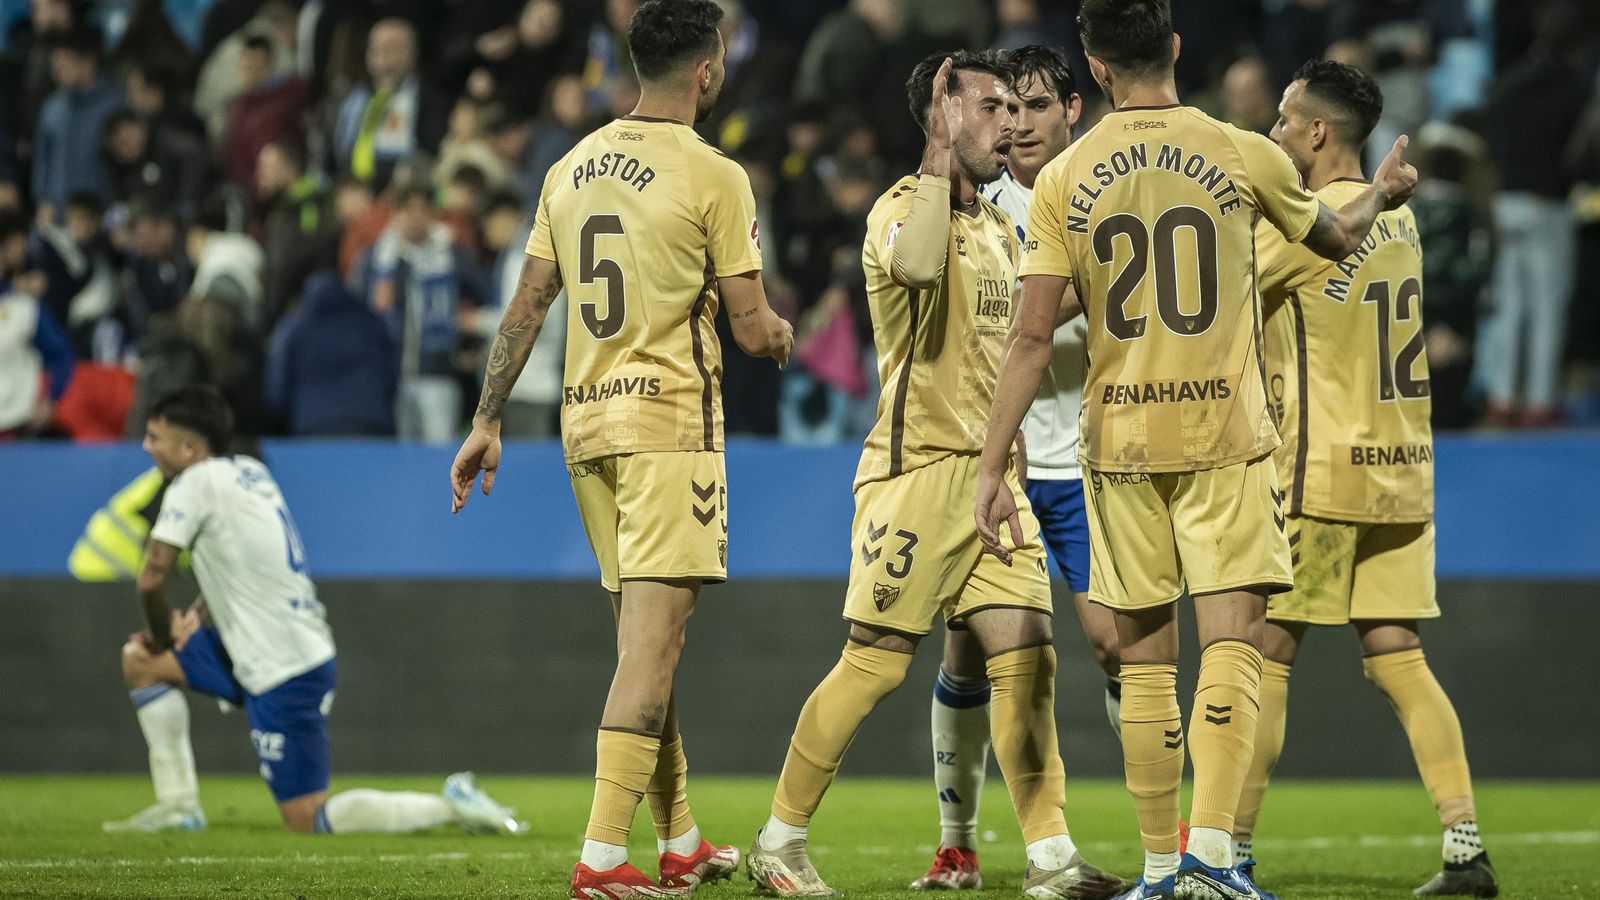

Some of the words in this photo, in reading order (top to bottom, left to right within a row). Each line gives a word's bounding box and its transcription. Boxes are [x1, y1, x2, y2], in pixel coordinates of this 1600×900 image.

[573, 152, 656, 193] PASTOR
[1066, 142, 1148, 234] NELSON
[1155, 143, 1241, 217] MONTE
[579, 213, 627, 340] 5
[1092, 205, 1218, 342] 20
[1361, 276, 1431, 403] 12
[1101, 379, 1231, 405] BENAHAVIS
[885, 528, 919, 580] 3
[936, 751, 958, 766] RZ
